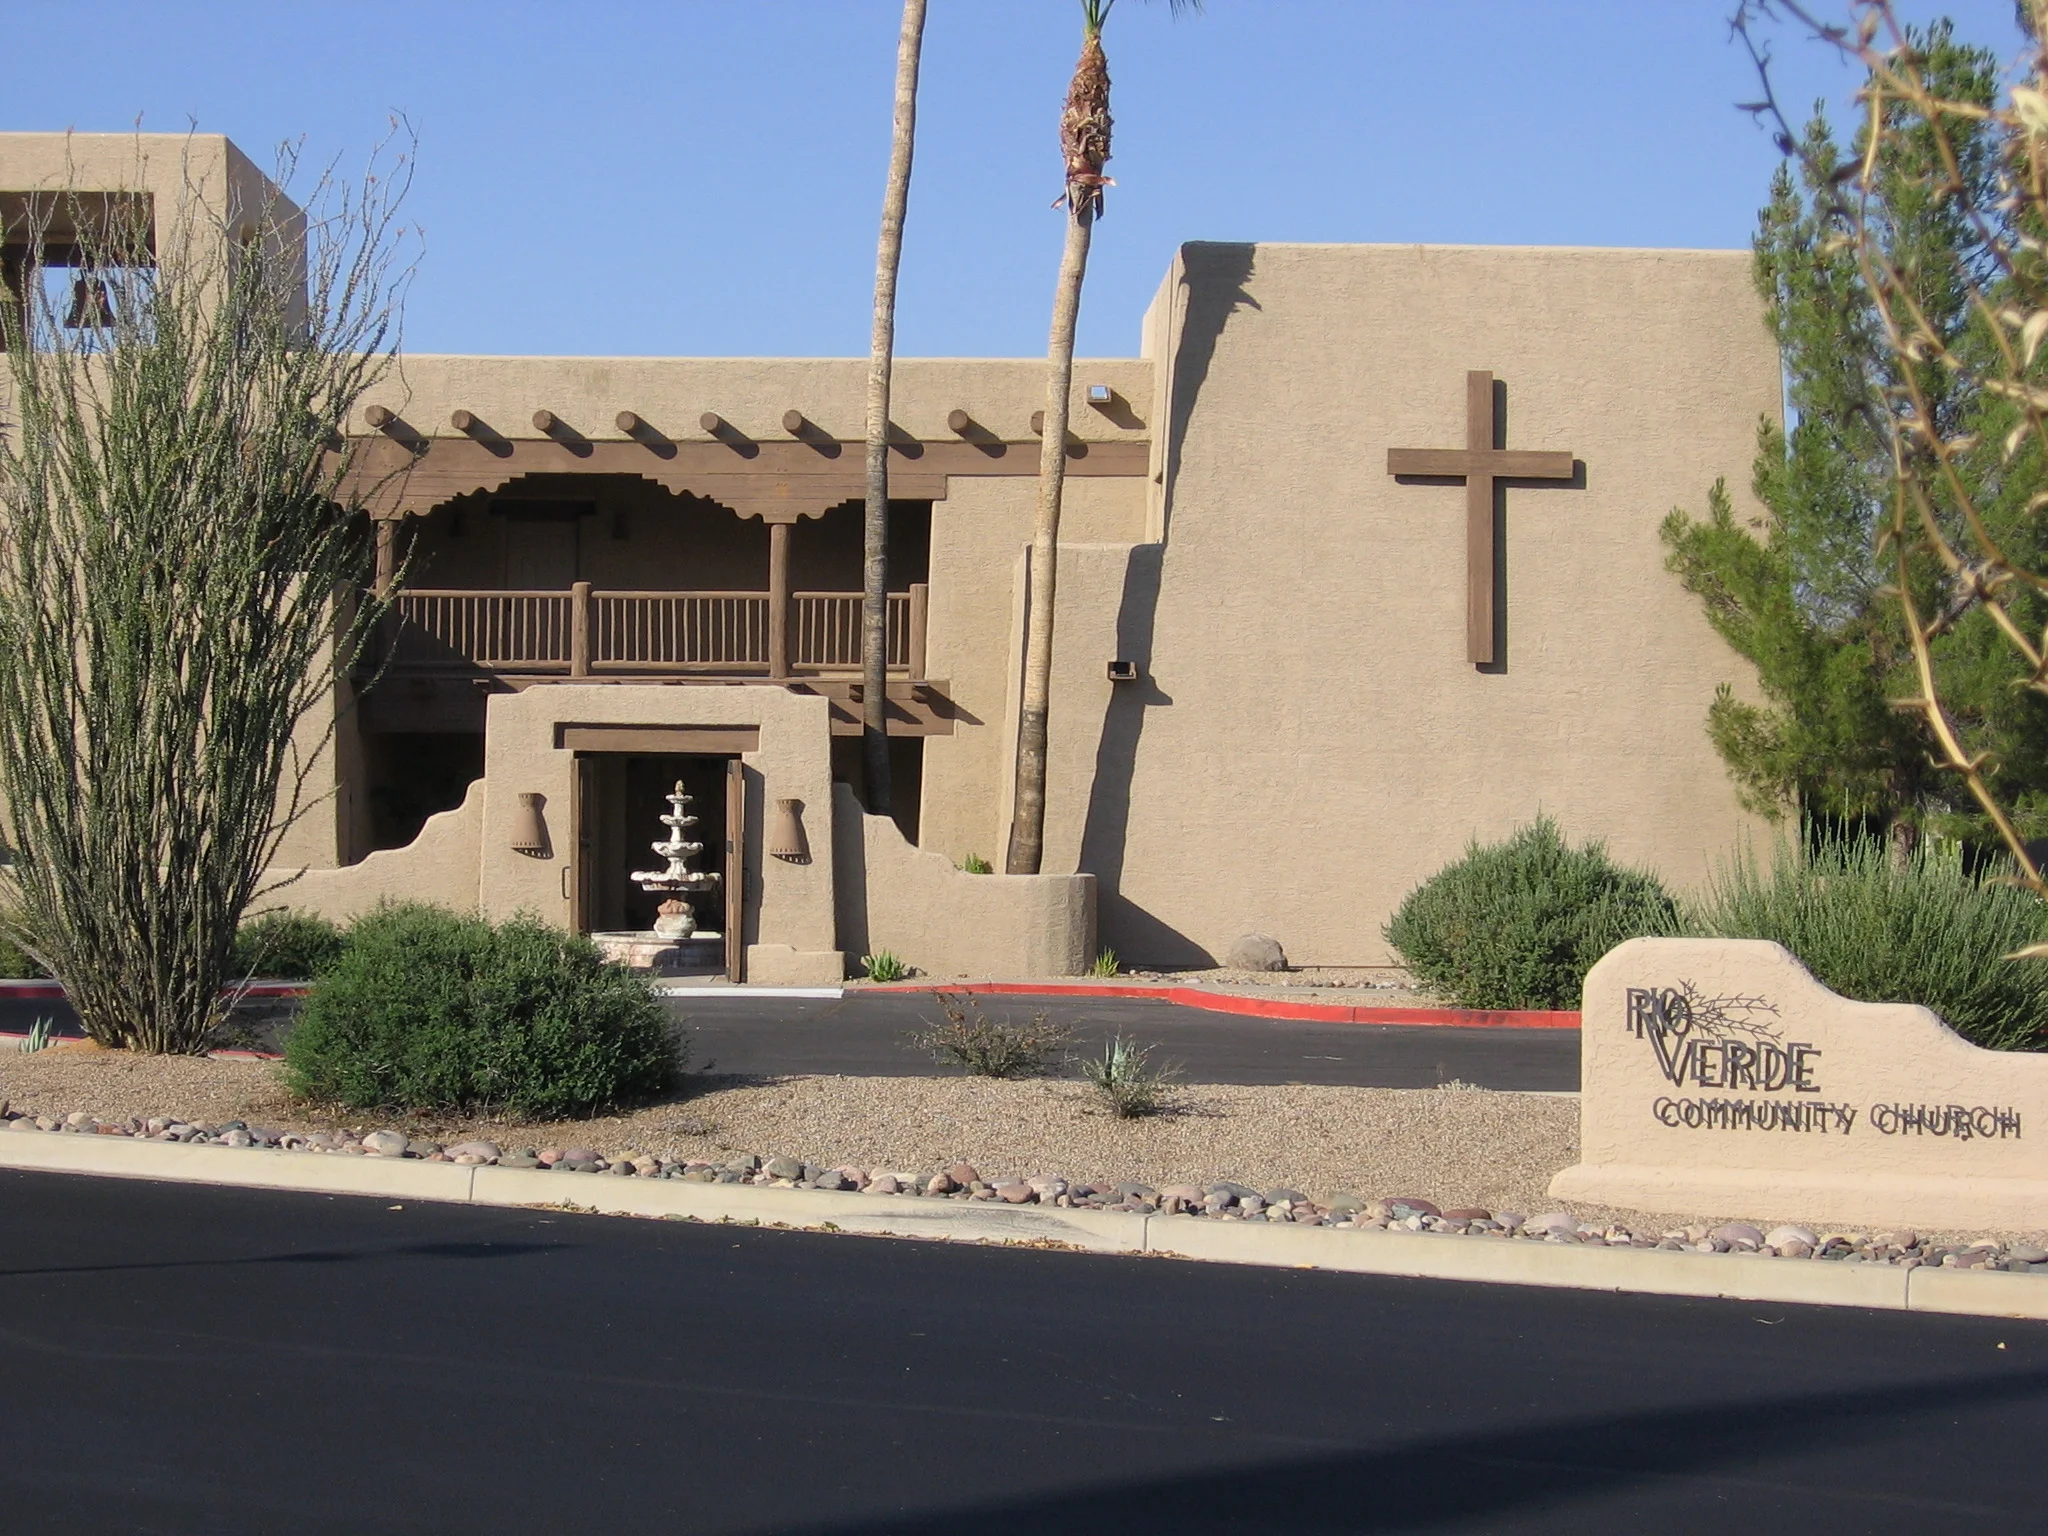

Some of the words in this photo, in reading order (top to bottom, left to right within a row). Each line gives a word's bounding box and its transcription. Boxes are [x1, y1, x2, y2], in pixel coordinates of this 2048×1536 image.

[1626, 987, 1690, 1037] RIO
[1641, 1021, 1820, 1091] VERDE
[1652, 1097, 1856, 1135] COMMUNITY
[1870, 1103, 2021, 1140] CHURCH
